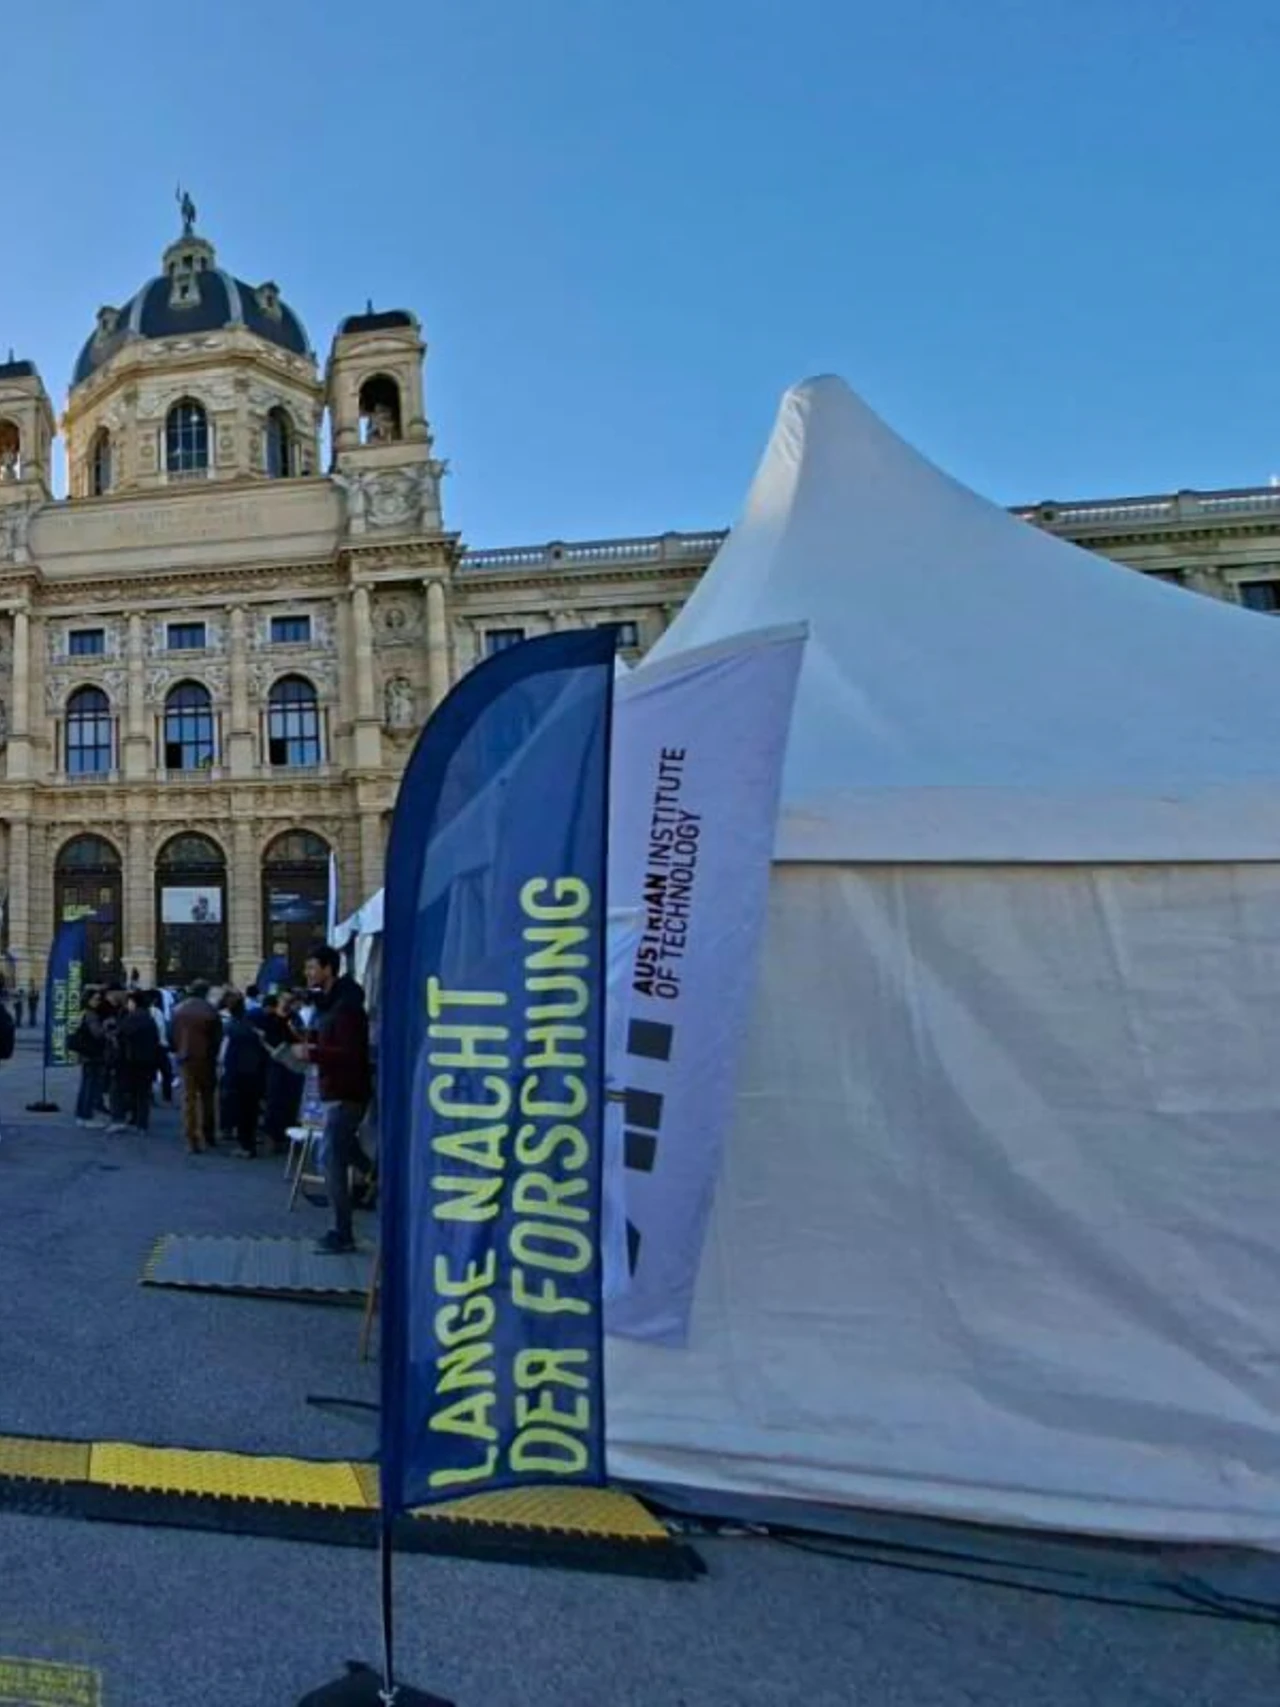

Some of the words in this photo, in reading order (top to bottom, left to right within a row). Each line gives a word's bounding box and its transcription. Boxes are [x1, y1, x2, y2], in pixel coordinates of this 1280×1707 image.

[647, 747, 687, 868] INSTITUTE
[632, 872, 668, 997] AUSTRIAN
[658, 809, 703, 959] TECHNOLOGY
[654, 967, 682, 1001] OF
[427, 977, 511, 1222] NACHT
[511, 877, 590, 1313] FORSCHUNG
[428, 1255, 497, 1487] LANGE
